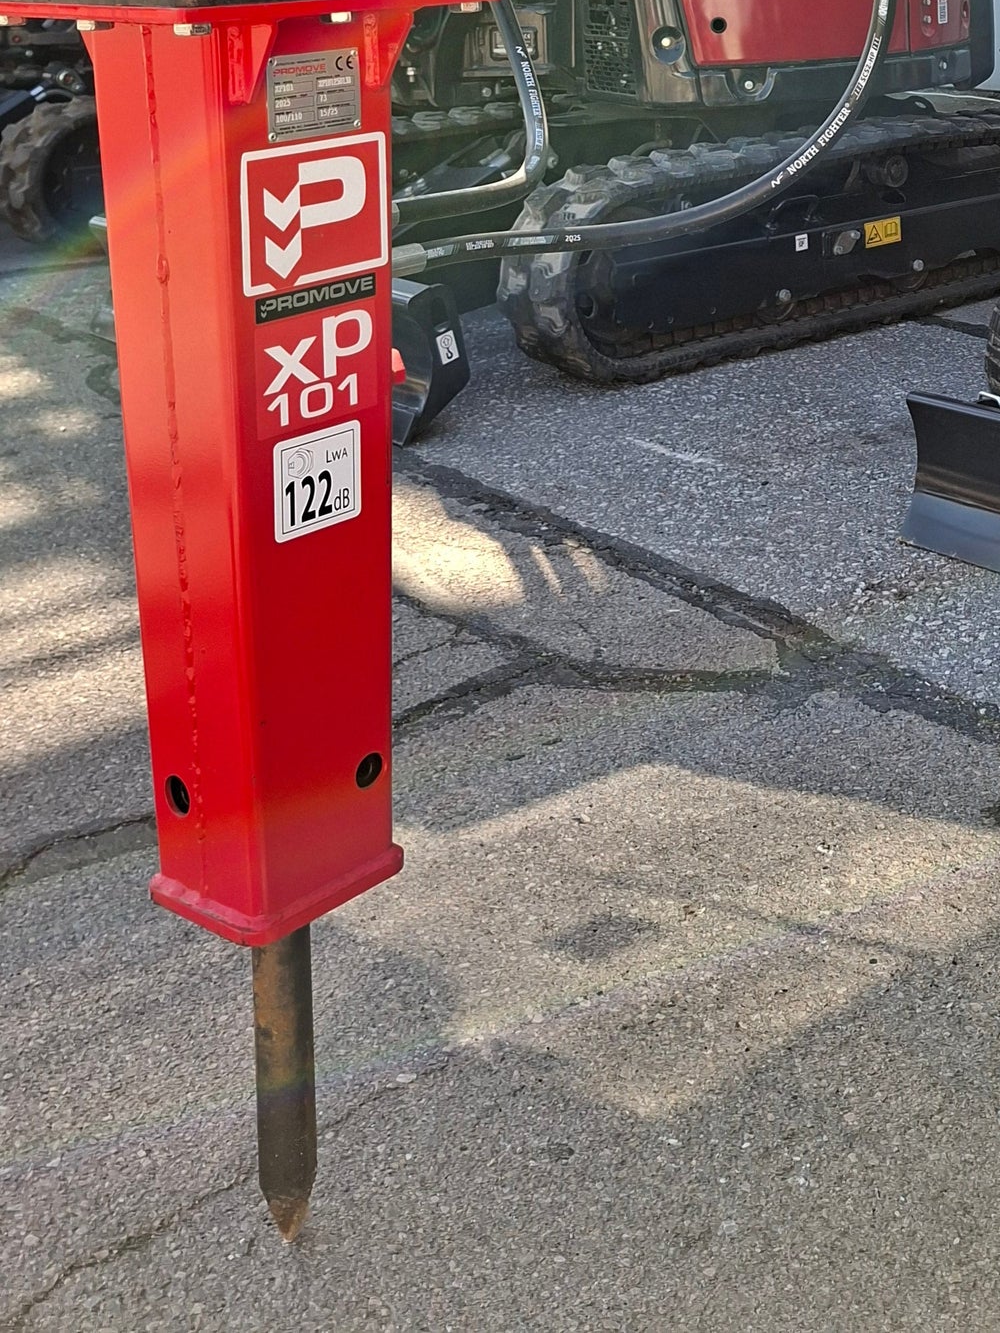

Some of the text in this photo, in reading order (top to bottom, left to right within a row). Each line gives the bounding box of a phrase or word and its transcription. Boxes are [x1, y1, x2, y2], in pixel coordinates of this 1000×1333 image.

[273, 63, 326, 77] PROMOVE
[520, 60, 535, 88] NORTH
[275, 94, 327, 108] 2025 73
[275, 112, 303, 123] 100/110
[320, 107, 338, 117] 15/25
[786, 145, 820, 176] NORTH
[564, 234, 582, 243] 2025
[260, 275, 374, 319] PROMOVE
[267, 373, 358, 427] 101
[285, 469, 350, 527] 122 dB
